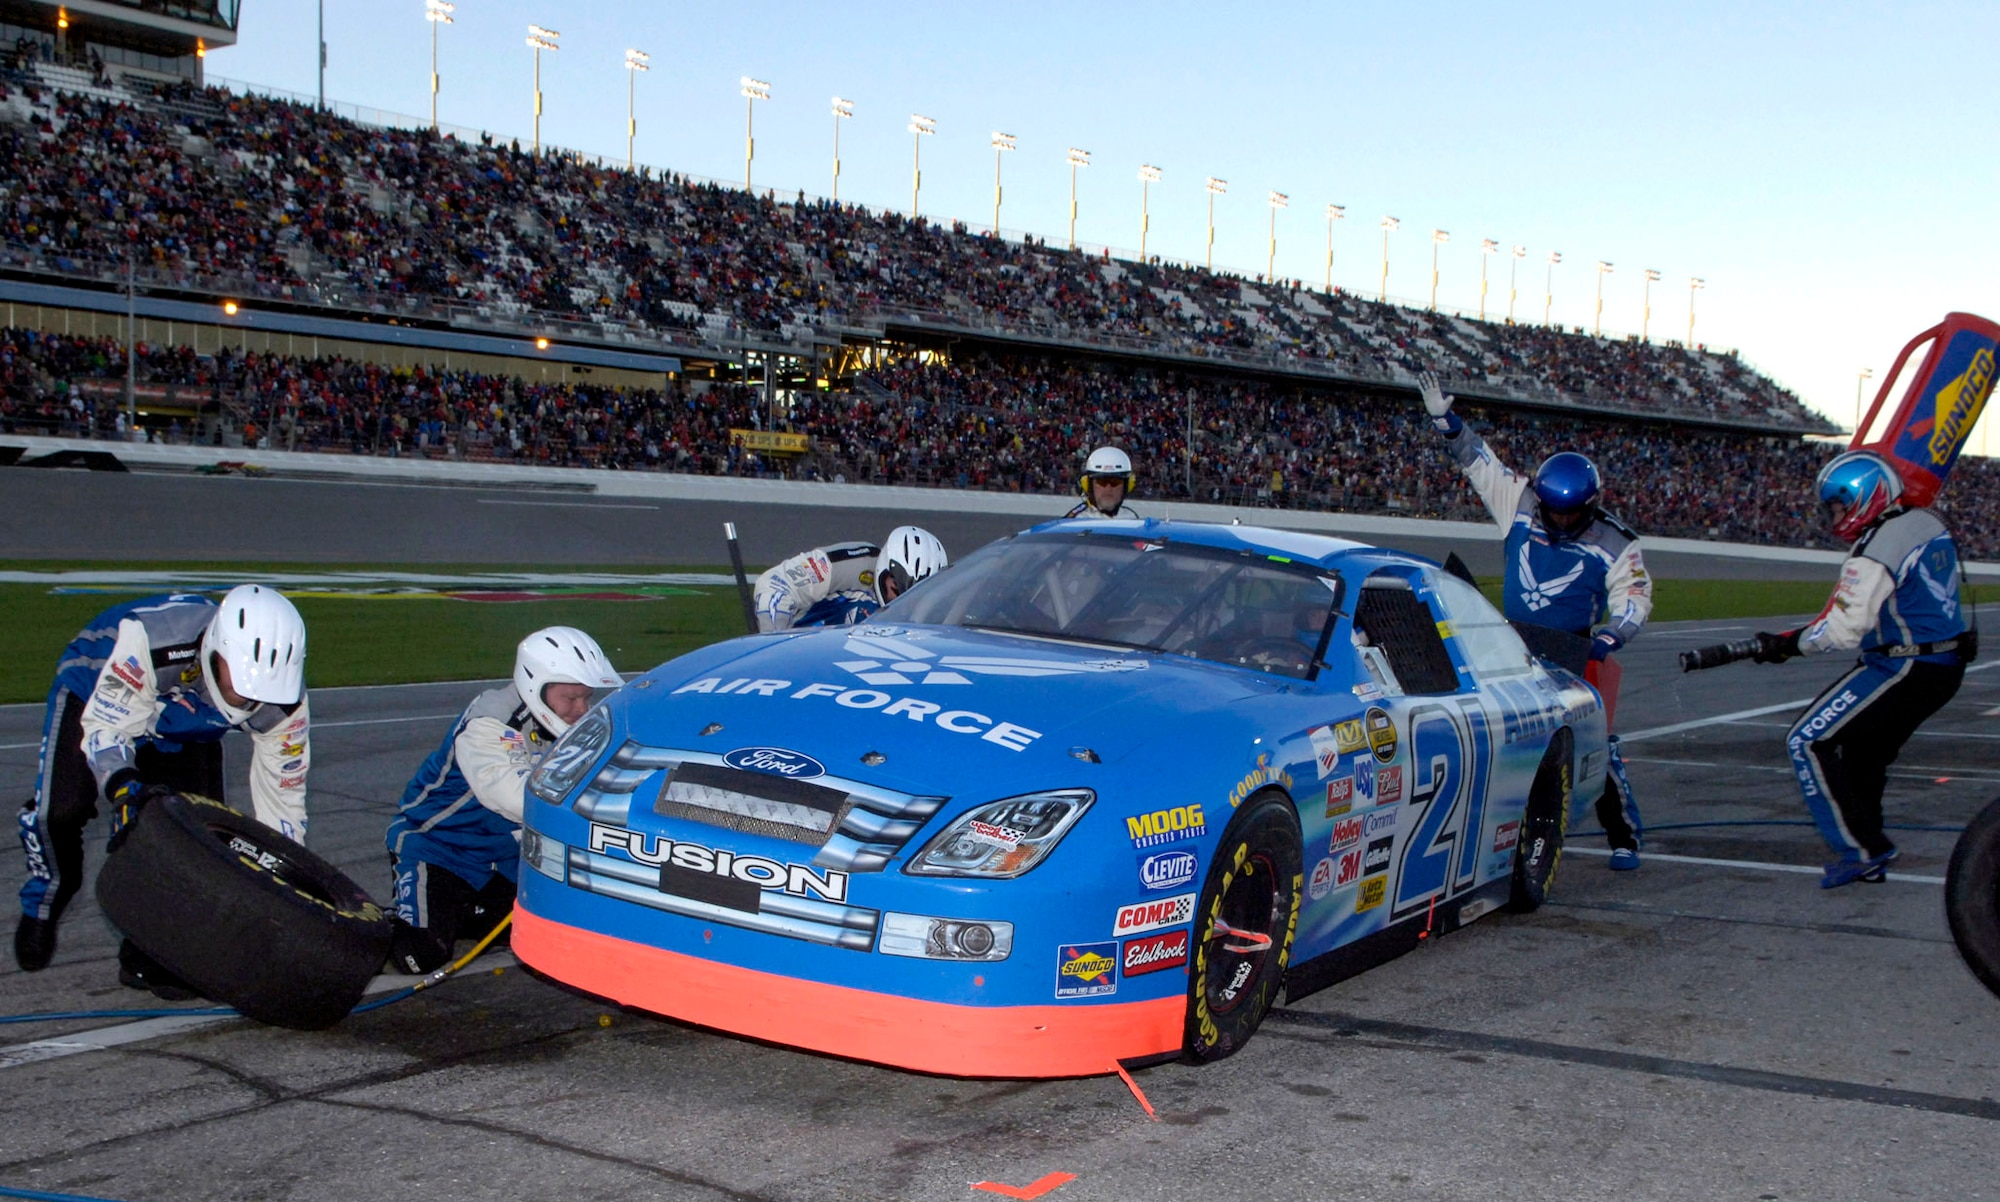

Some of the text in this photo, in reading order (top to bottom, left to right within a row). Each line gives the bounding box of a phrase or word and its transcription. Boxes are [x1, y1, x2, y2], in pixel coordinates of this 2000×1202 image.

[1931, 352, 1993, 461] SUNOCO
[1931, 549, 1948, 572] 21
[98, 674, 135, 706] 21
[671, 677, 1044, 752] AIR FORCE
[1788, 735, 1807, 762] AIR
[1800, 689, 1859, 739] FORCE
[541, 744, 595, 773] 21
[739, 750, 808, 776] Ford
[1378, 770, 1401, 794] Bud
[1126, 803, 1205, 840] MOOG
[1389, 696, 1495, 923] 21
[970, 821, 1003, 834] wood
[976, 825, 1017, 842] brothers
[1135, 825, 1206, 849] CHASSIS PARTS
[1332, 819, 1362, 844] Holley
[589, 821, 848, 904] FUSION
[1143, 856, 1194, 884] CLEVITE
[1337, 850, 1362, 885] 3M
[1365, 846, 1391, 868] Gillette
[1313, 861, 1331, 884] EA
[1118, 901, 1176, 929] COMP
[1158, 913, 1185, 925] CAMS
[1278, 872, 1304, 973] EAGLE
[1063, 959, 1114, 974] SUNOCO
[1124, 937, 1187, 968] Edelbrock
